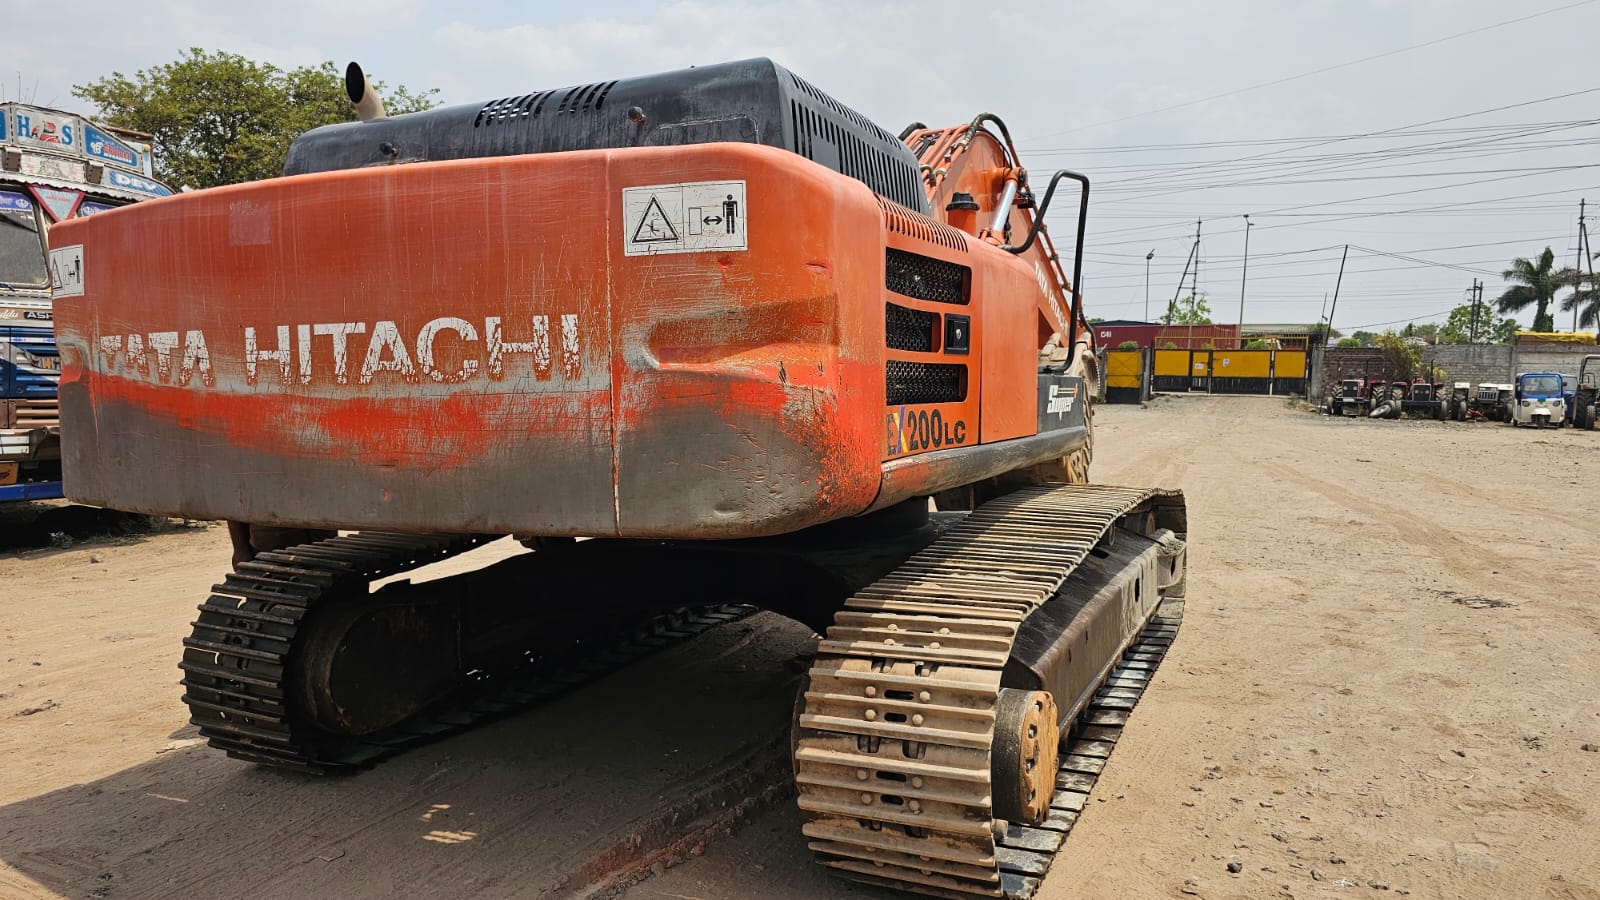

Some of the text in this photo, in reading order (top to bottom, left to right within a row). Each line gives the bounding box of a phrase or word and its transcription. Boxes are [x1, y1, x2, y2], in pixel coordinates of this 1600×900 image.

[1035, 260, 1048, 298] TATA
[99, 314, 582, 386] TATA HITACHI
